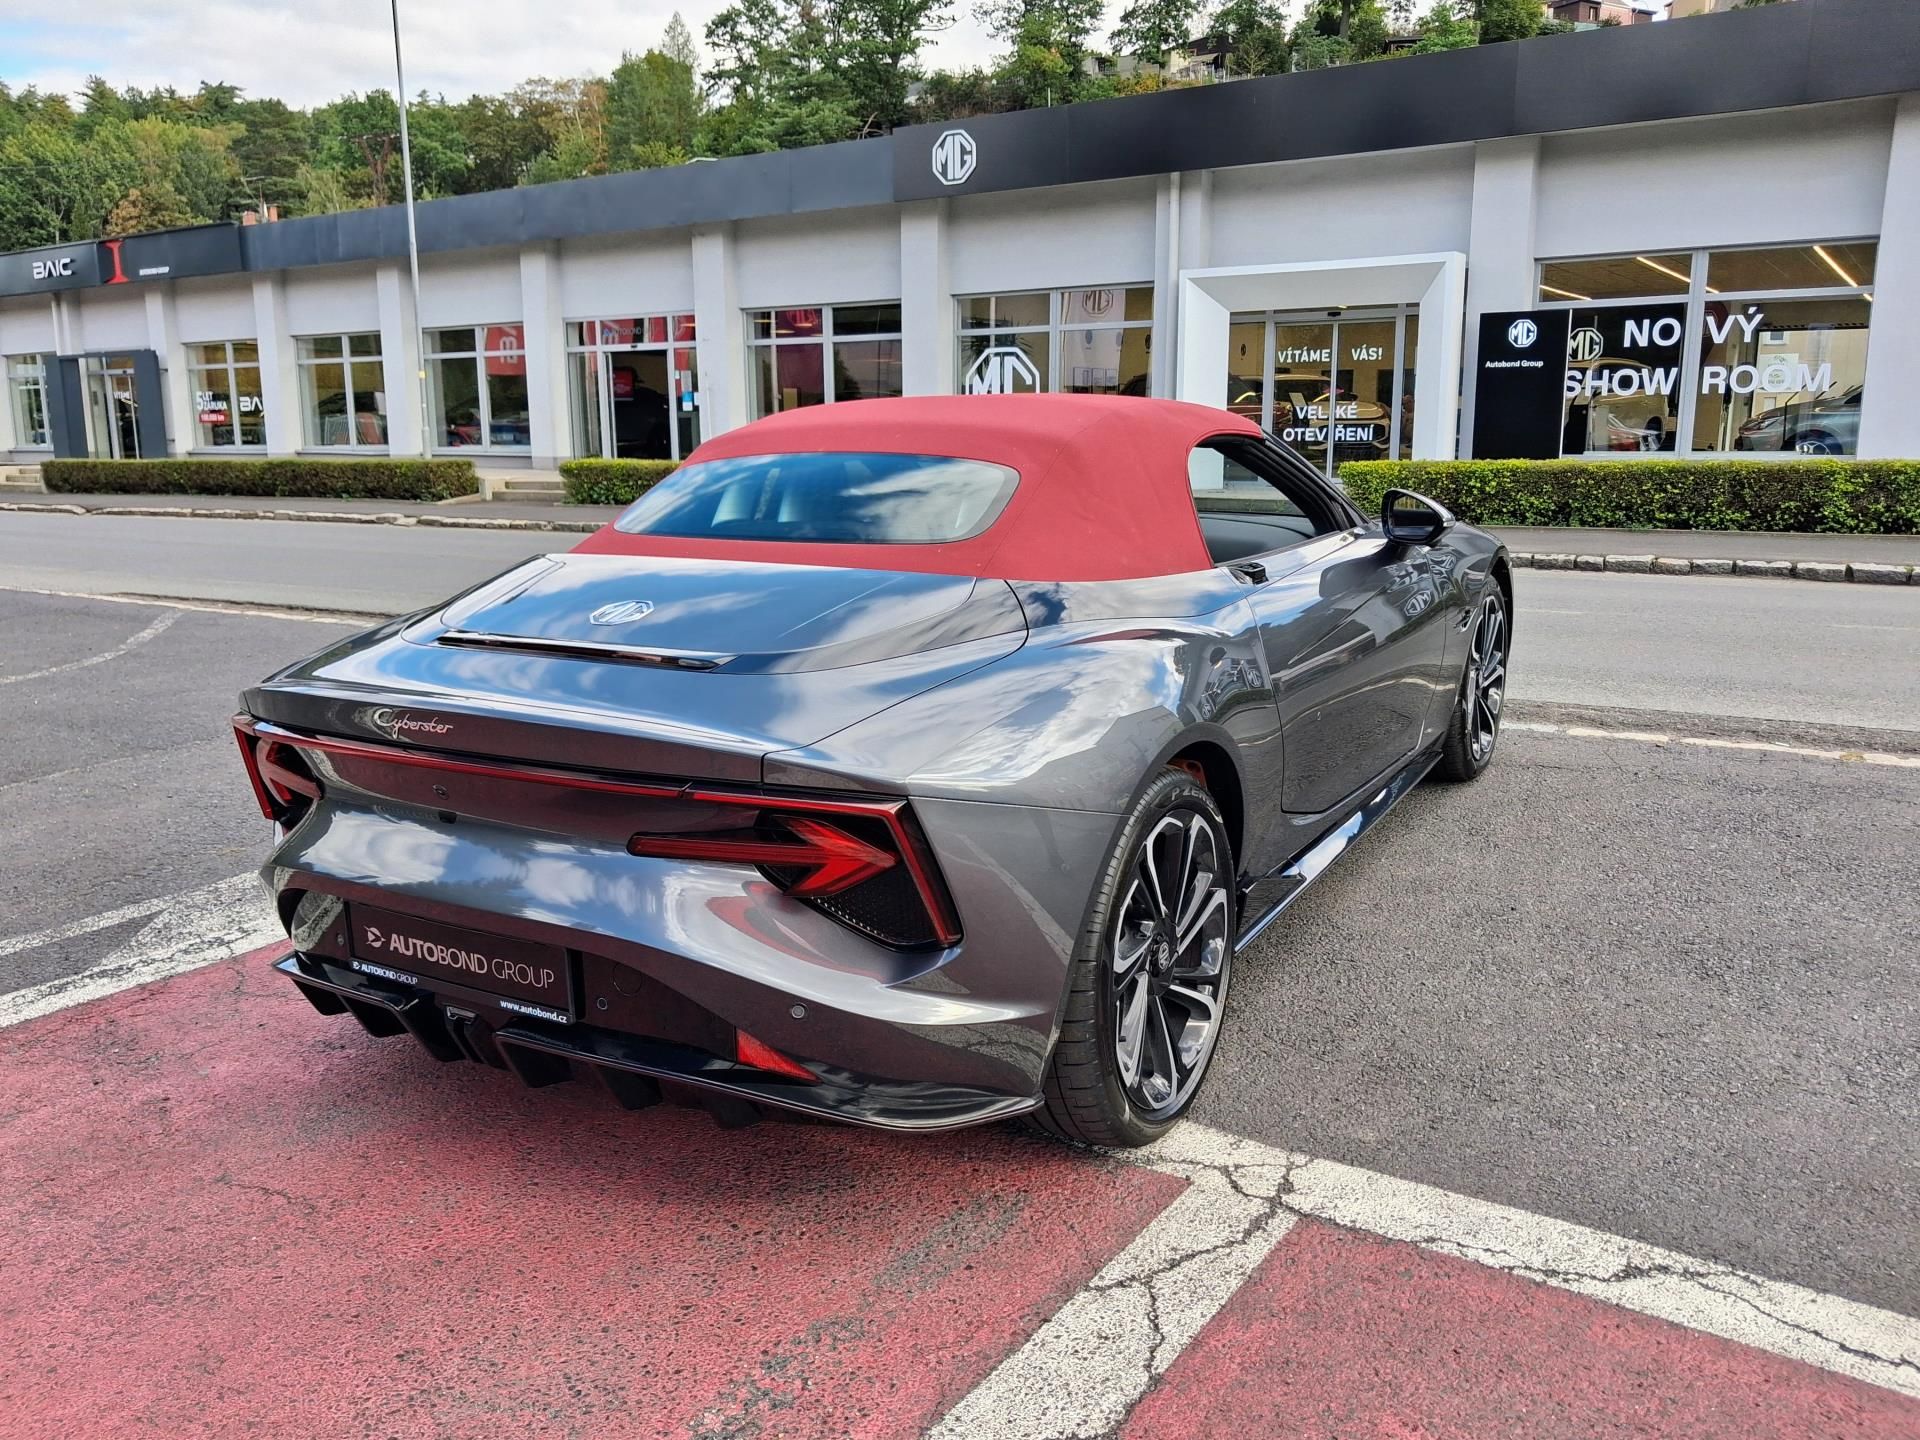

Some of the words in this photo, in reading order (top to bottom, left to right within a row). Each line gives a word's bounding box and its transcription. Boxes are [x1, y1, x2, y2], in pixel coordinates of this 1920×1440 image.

[935, 133, 973, 181] MG
[32, 257, 73, 280] BAIC
[1511, 321, 1536, 346] MG
[1568, 330, 1600, 361] MG
[1277, 346, 1331, 363] VÍTÁME
[1351, 344, 1383, 361] VÁS!
[1485, 360, 1520, 368] Autobond
[1521, 360, 1544, 368] Group
[374, 708, 454, 739] Cyberster
[389, 933, 488, 975] AUTOBOND
[491, 958, 555, 989] GROUP
[360, 964, 396, 981] AUTOBOND
[396, 973, 418, 986] GROUP
[499, 1000, 568, 1024] www.autobond.cz
